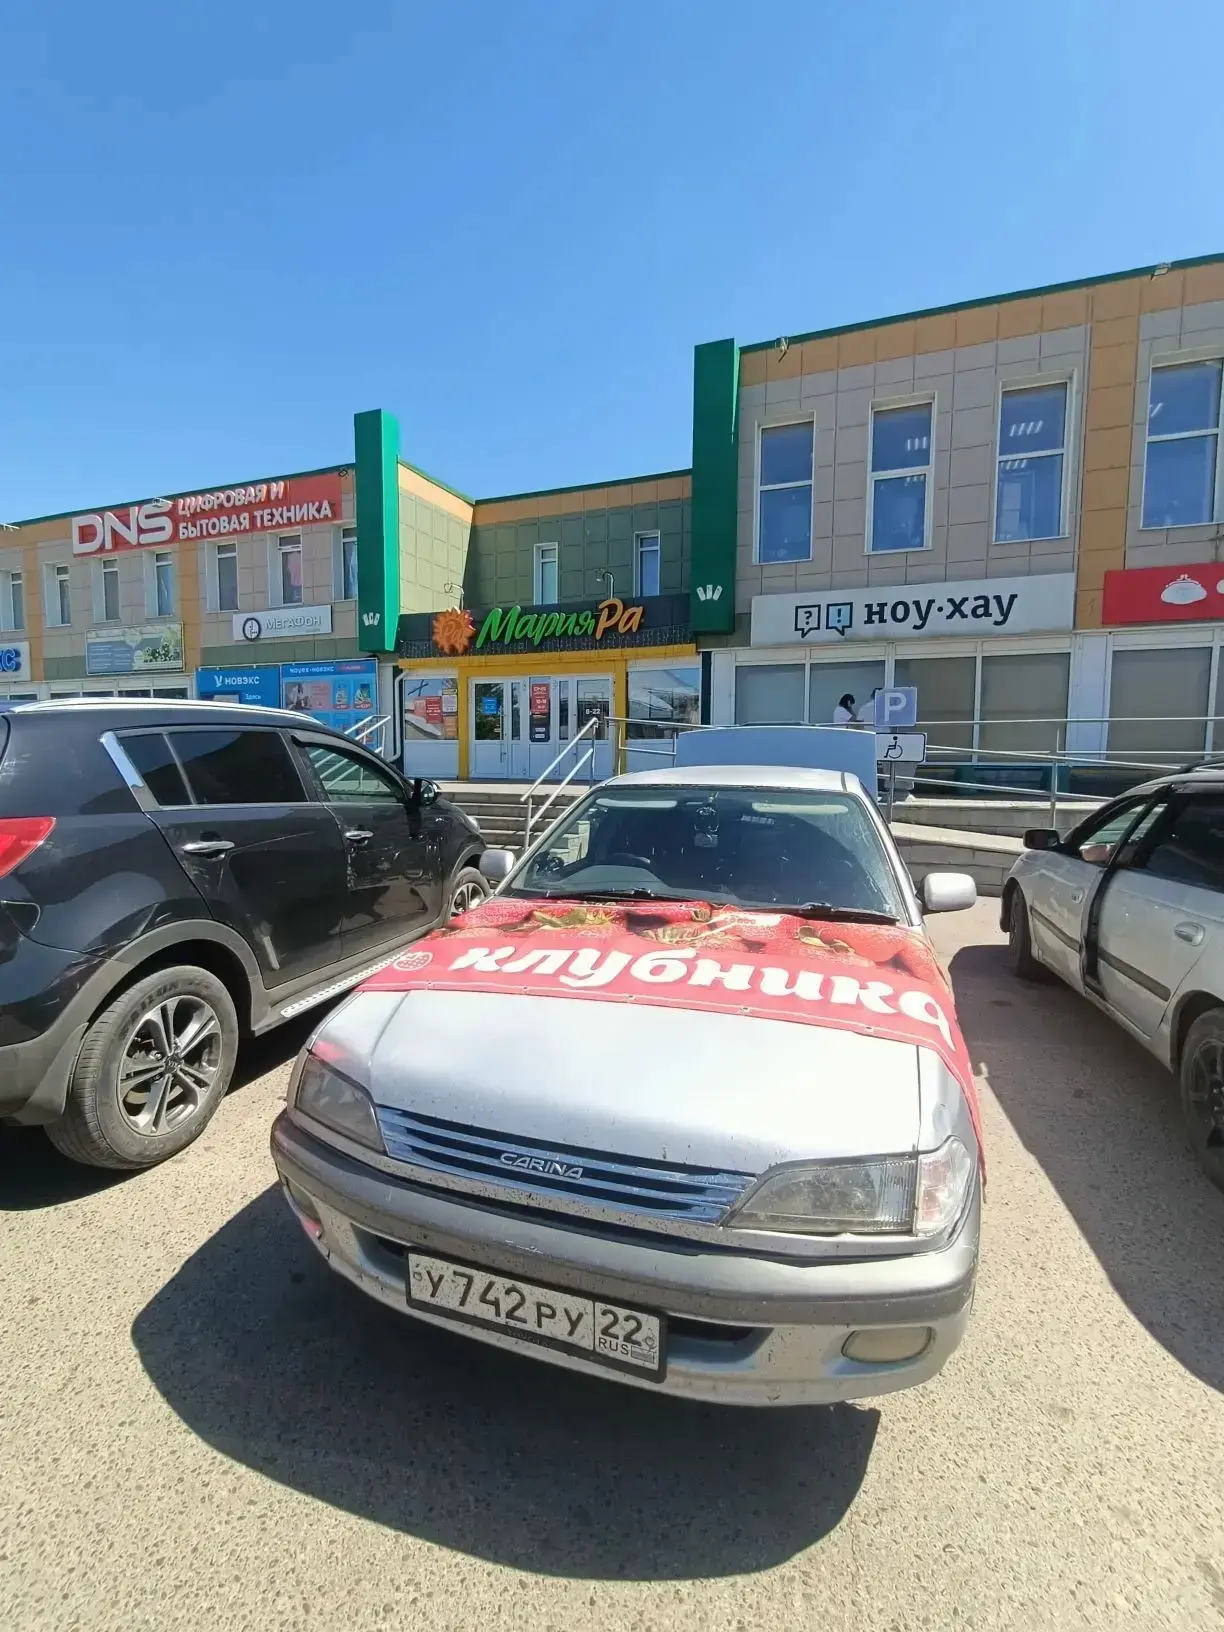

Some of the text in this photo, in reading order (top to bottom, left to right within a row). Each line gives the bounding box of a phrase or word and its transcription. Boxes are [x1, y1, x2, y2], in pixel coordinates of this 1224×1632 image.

[177, 480, 285, 515] ЦИФРОВАЯ И
[71, 502, 173, 555] DNS
[178, 499, 332, 540] БЫТОВАЯ ТЕХНИКА
[0, 648, 20, 672] С
[224, 676, 260, 685] НОВЭКС
[883, 692, 907, 722] P
[449, 945, 955, 1050] клубника
[500, 1152, 583, 1180] CARINA
[425, 1269, 644, 1347] У742РУ 22
[598, 1336, 631, 1356] RUS
